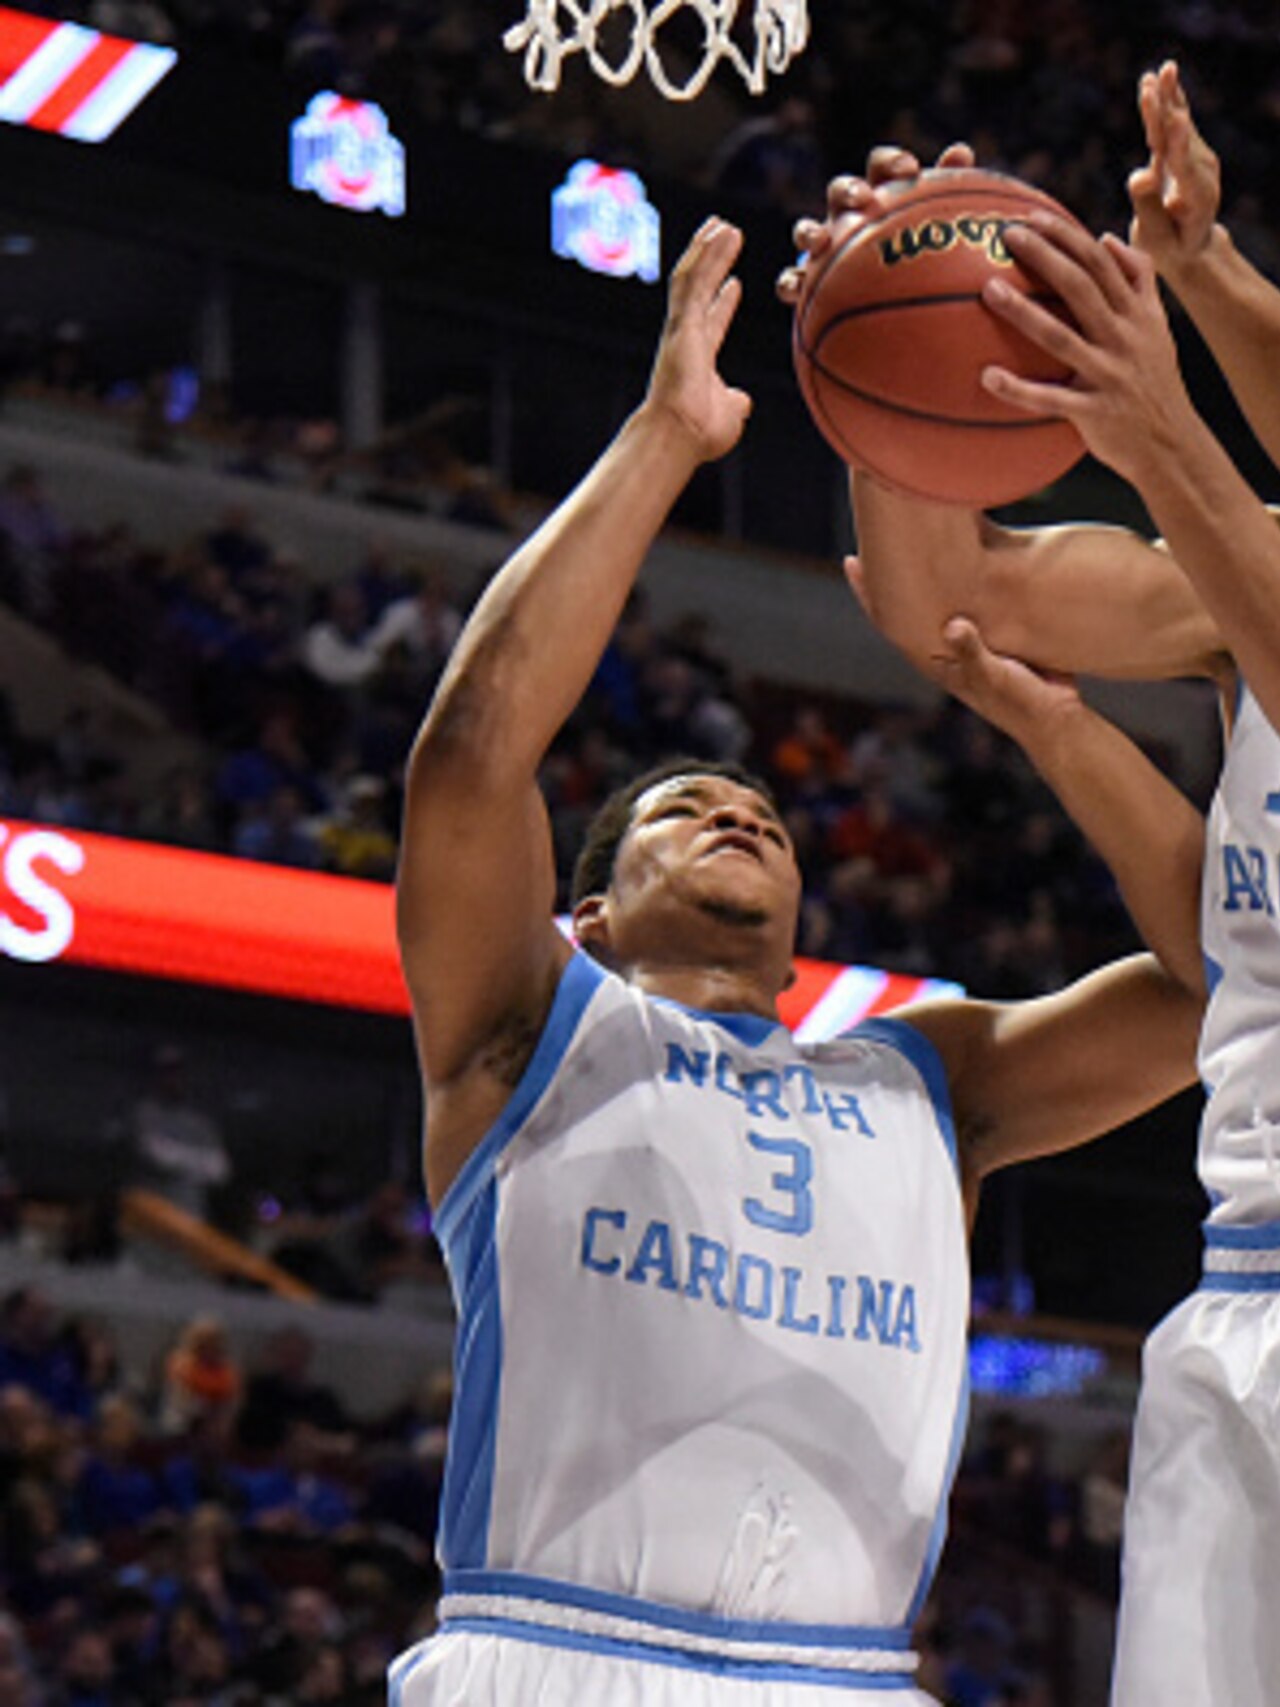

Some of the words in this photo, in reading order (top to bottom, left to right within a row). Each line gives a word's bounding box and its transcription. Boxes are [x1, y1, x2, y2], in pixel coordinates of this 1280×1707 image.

[879, 213, 1022, 268] lson
[663, 1041, 876, 1139] NORTH
[742, 1129, 813, 1238] 3
[580, 1206, 923, 1353] CAROLINA
